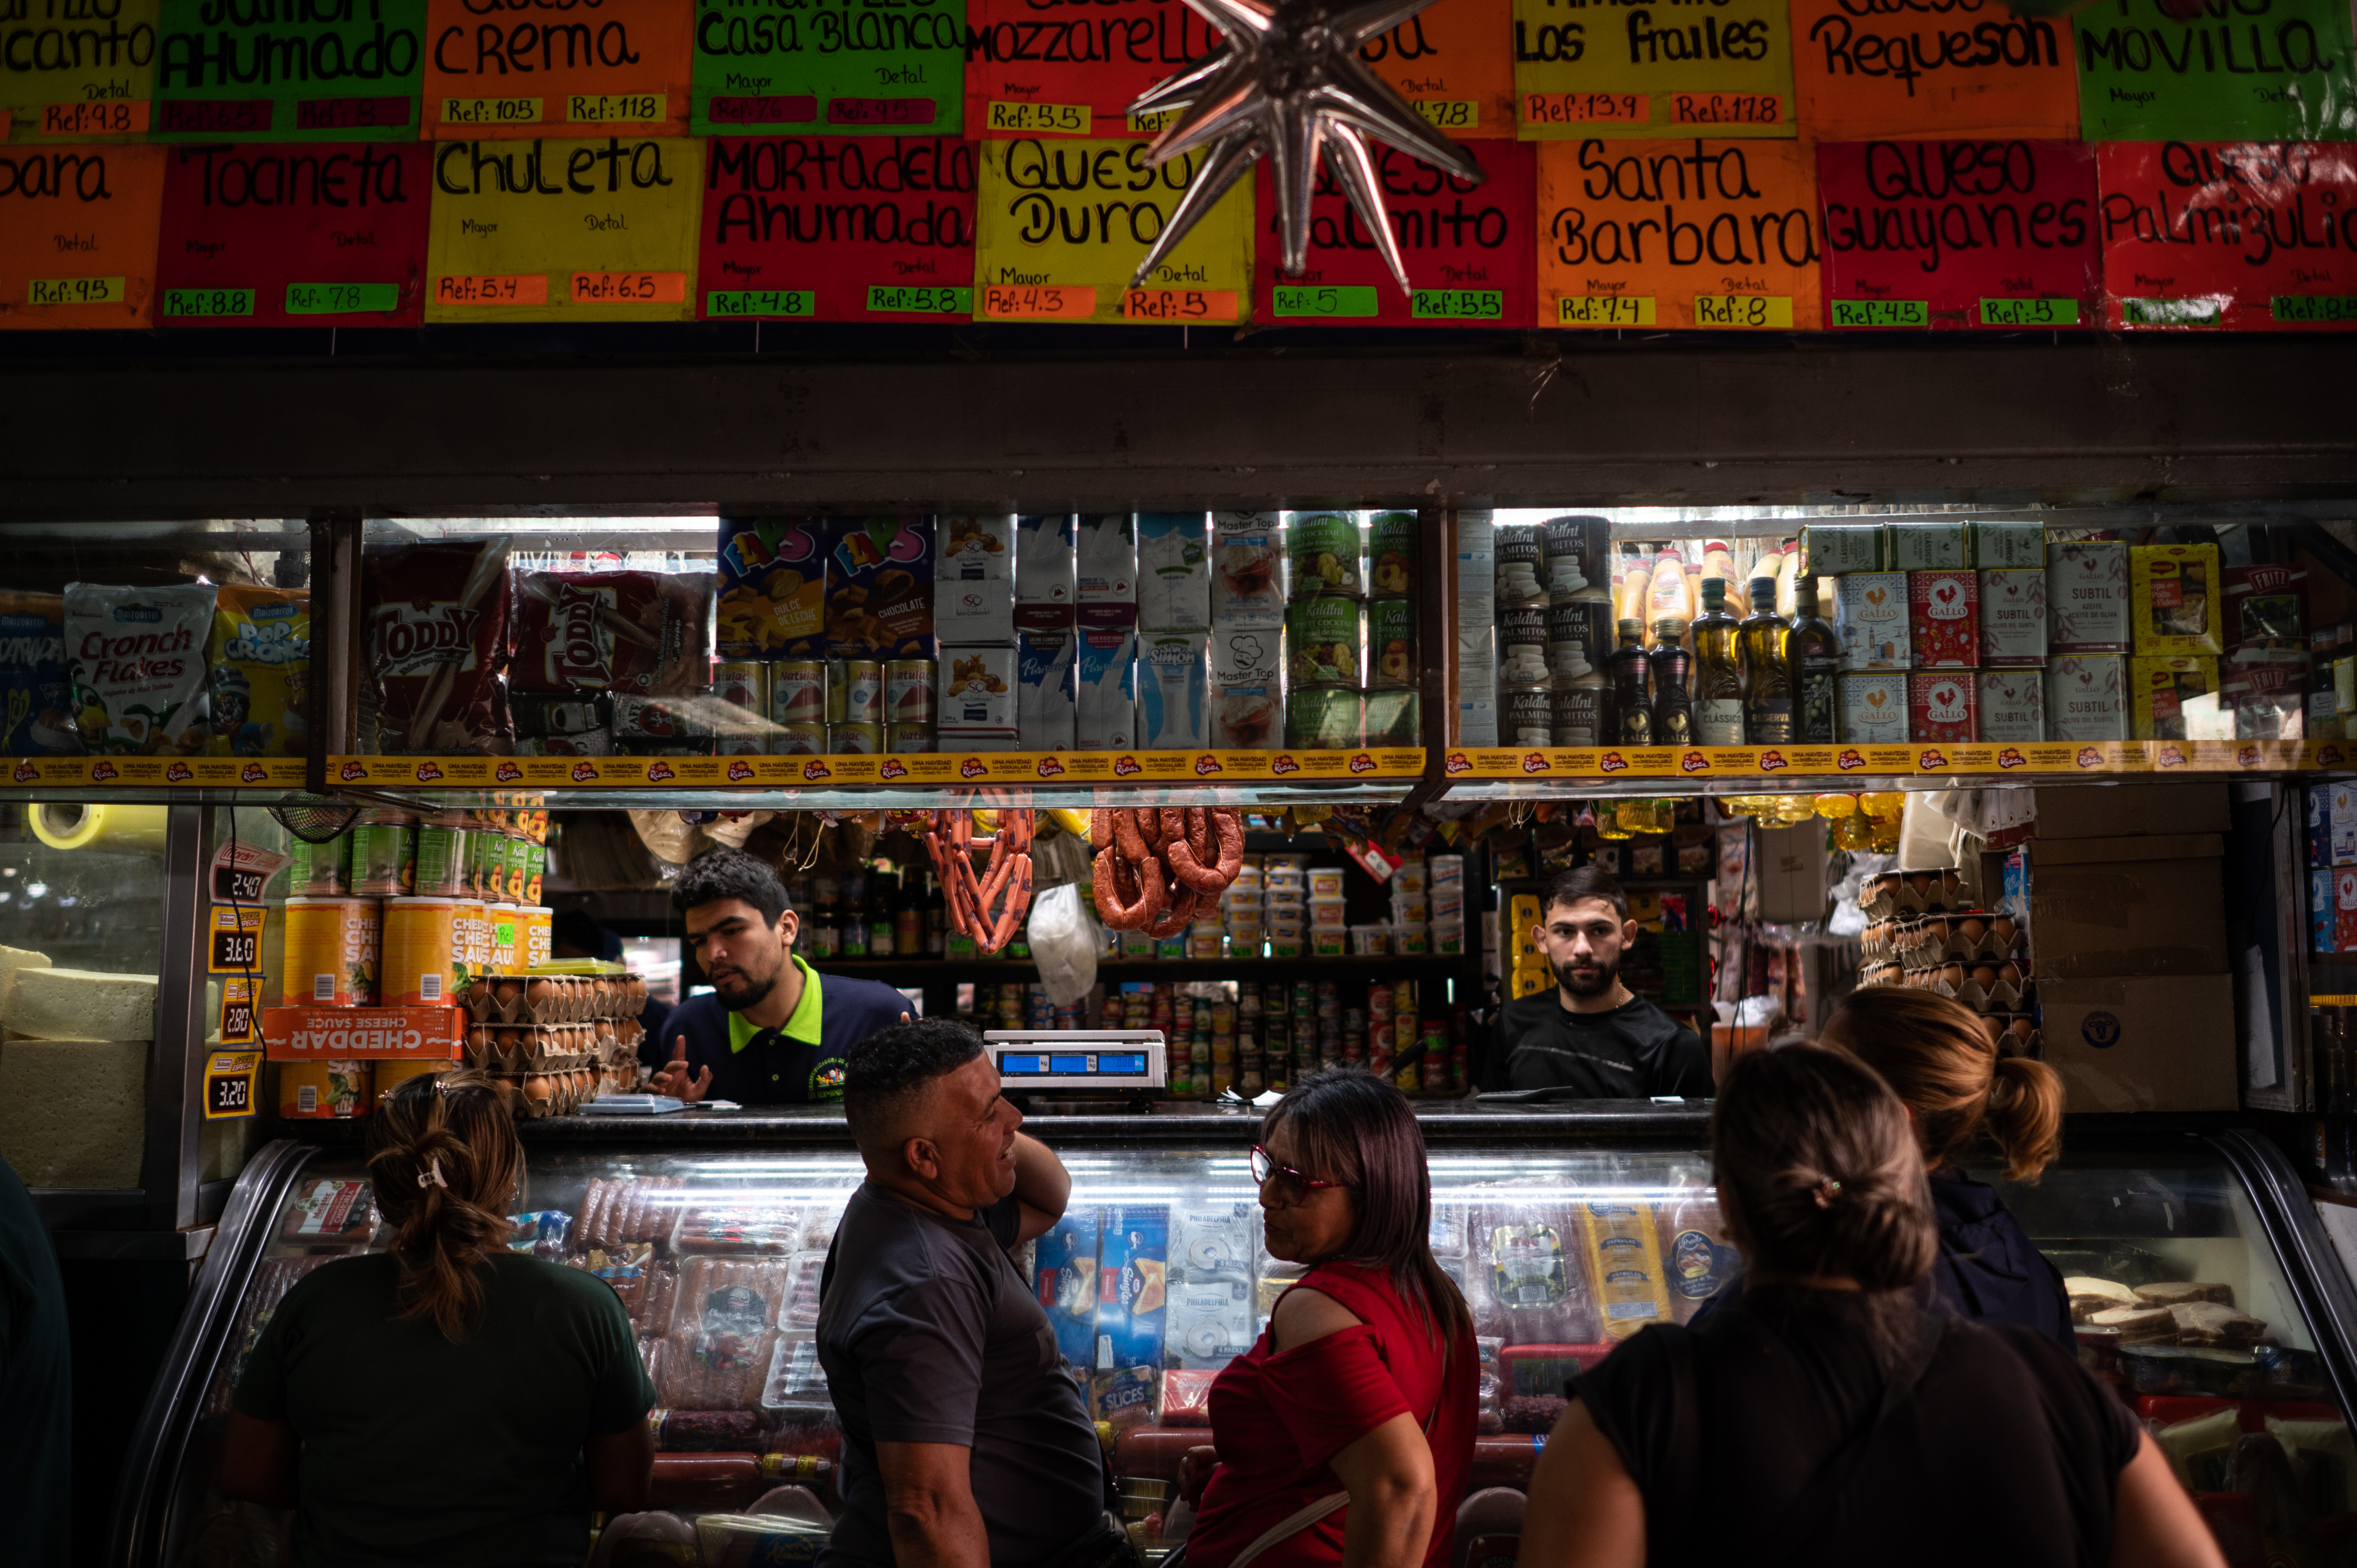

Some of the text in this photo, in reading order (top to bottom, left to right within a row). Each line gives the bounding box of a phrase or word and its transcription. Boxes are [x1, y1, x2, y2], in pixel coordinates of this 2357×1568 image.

[727, 72, 773, 96] Mayor
[875, 64, 927, 85] Detal
[83, 79, 132, 99] Detal
[2110, 87, 2156, 108] Mayor
[1578, 137, 1761, 203] Santa
[462, 218, 499, 239] Mayor
[584, 213, 629, 231] Detal
[54, 233, 100, 253] Detal
[1552, 205, 1820, 268] Barbara
[1000, 266, 1052, 286] Mayor
[1157, 264, 1208, 283] Detal
[1440, 263, 1488, 283] Detal
[1586, 279, 1628, 294] Mayor
[1720, 277, 1769, 294] Detal
[2254, 569, 2291, 590] FRITZ
[2072, 588, 2112, 599] SUBTIL
[774, 598, 801, 617] DULCE
[778, 608, 817, 626] DE LECHE
[878, 597, 925, 620] CHOCOLATE
[1859, 608, 1896, 618] GALLO
[1930, 607, 1966, 617] GALLO
[1997, 609, 2031, 619] SUBTIL
[238, 621, 292, 643] POP
[1500, 627, 1547, 636] PALMITOS
[80, 623, 192, 661] Cronch
[92, 657, 184, 685] Flakes
[780, 670, 821, 682] Natulac
[1217, 668, 1274, 681] Master Top
[307, 1018, 407, 1028] CHEESE SAUCE
[291, 1029, 421, 1049] CHEDDAR
[1187, 1297, 1229, 1307] PHILADELPHIA
[1106, 1386, 1145, 1410] SLICES
